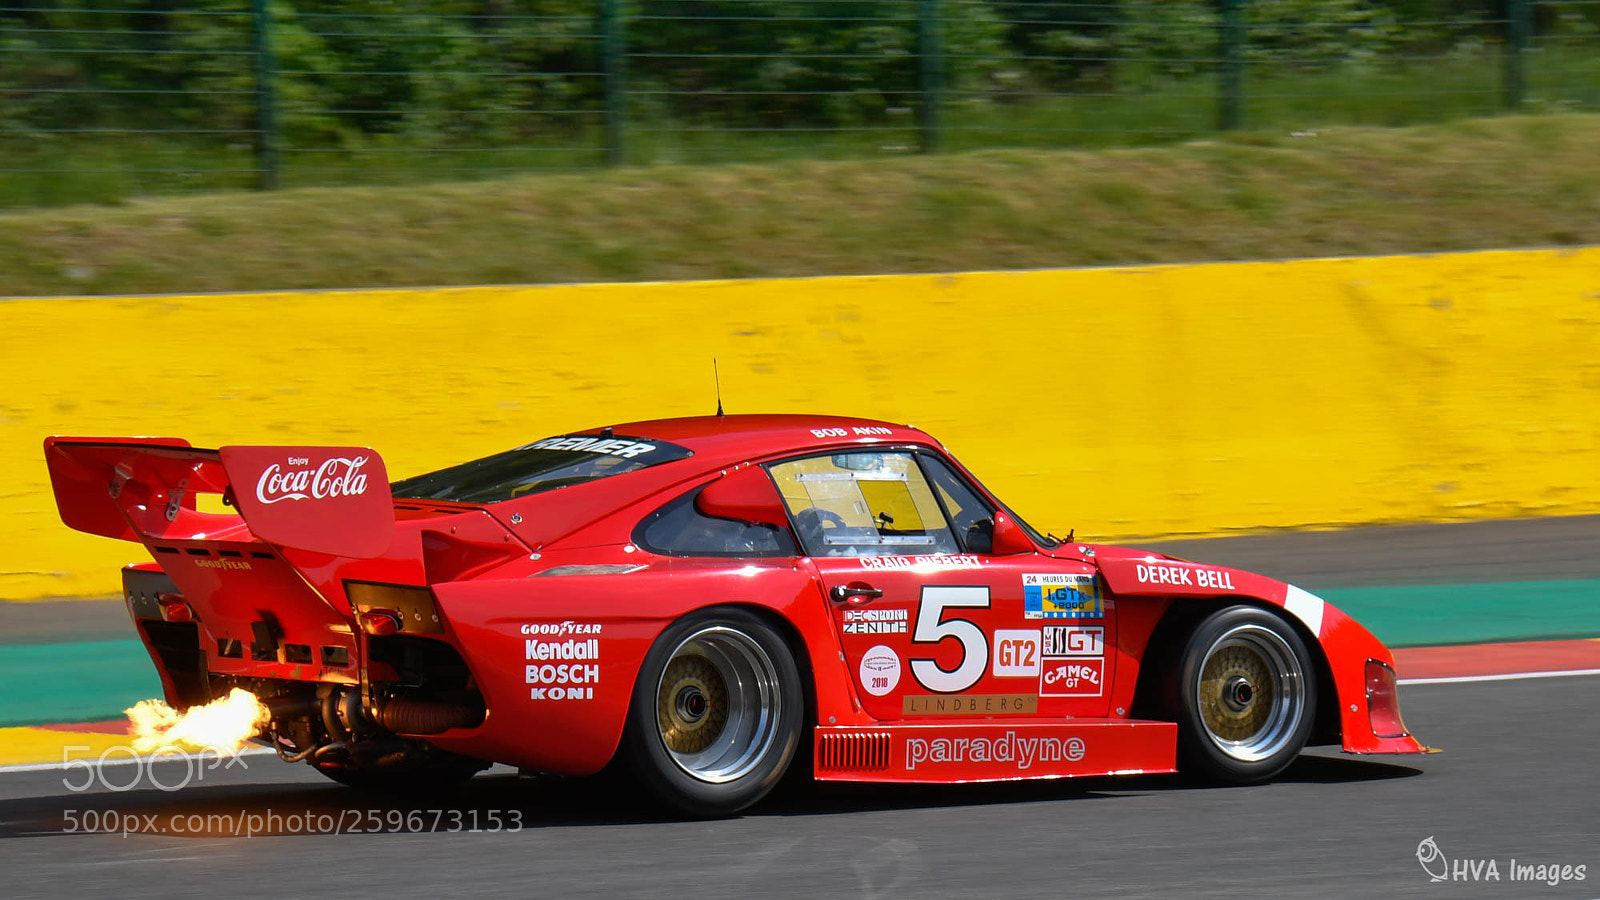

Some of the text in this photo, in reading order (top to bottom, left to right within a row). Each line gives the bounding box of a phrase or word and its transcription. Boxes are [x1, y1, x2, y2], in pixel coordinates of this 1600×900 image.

[810, 427, 893, 438] BOB AKIN
[287, 456, 309, 466] Enjoy
[194, 558, 253, 570] GOODYEAR
[859, 555, 911, 571] CRAIG
[1026, 575, 1037, 584] 24
[1136, 564, 1235, 590] DEREK BELL
[520, 620, 602, 637] GOODYEAR
[843, 621, 909, 634] ZENITH
[909, 585, 991, 695] 5
[1067, 630, 1102, 651] GT
[525, 639, 599, 660] Kendall
[999, 639, 1036, 667] GT2
[525, 664, 599, 684] BOSCH
[1044, 665, 1100, 685] CAMEL
[872, 677, 889, 688] 2018
[1066, 678, 1079, 688] GT
[530, 687, 594, 700] KONI
[911, 698, 1023, 711] LINDBERG
[905, 731, 1086, 770] paradyne
